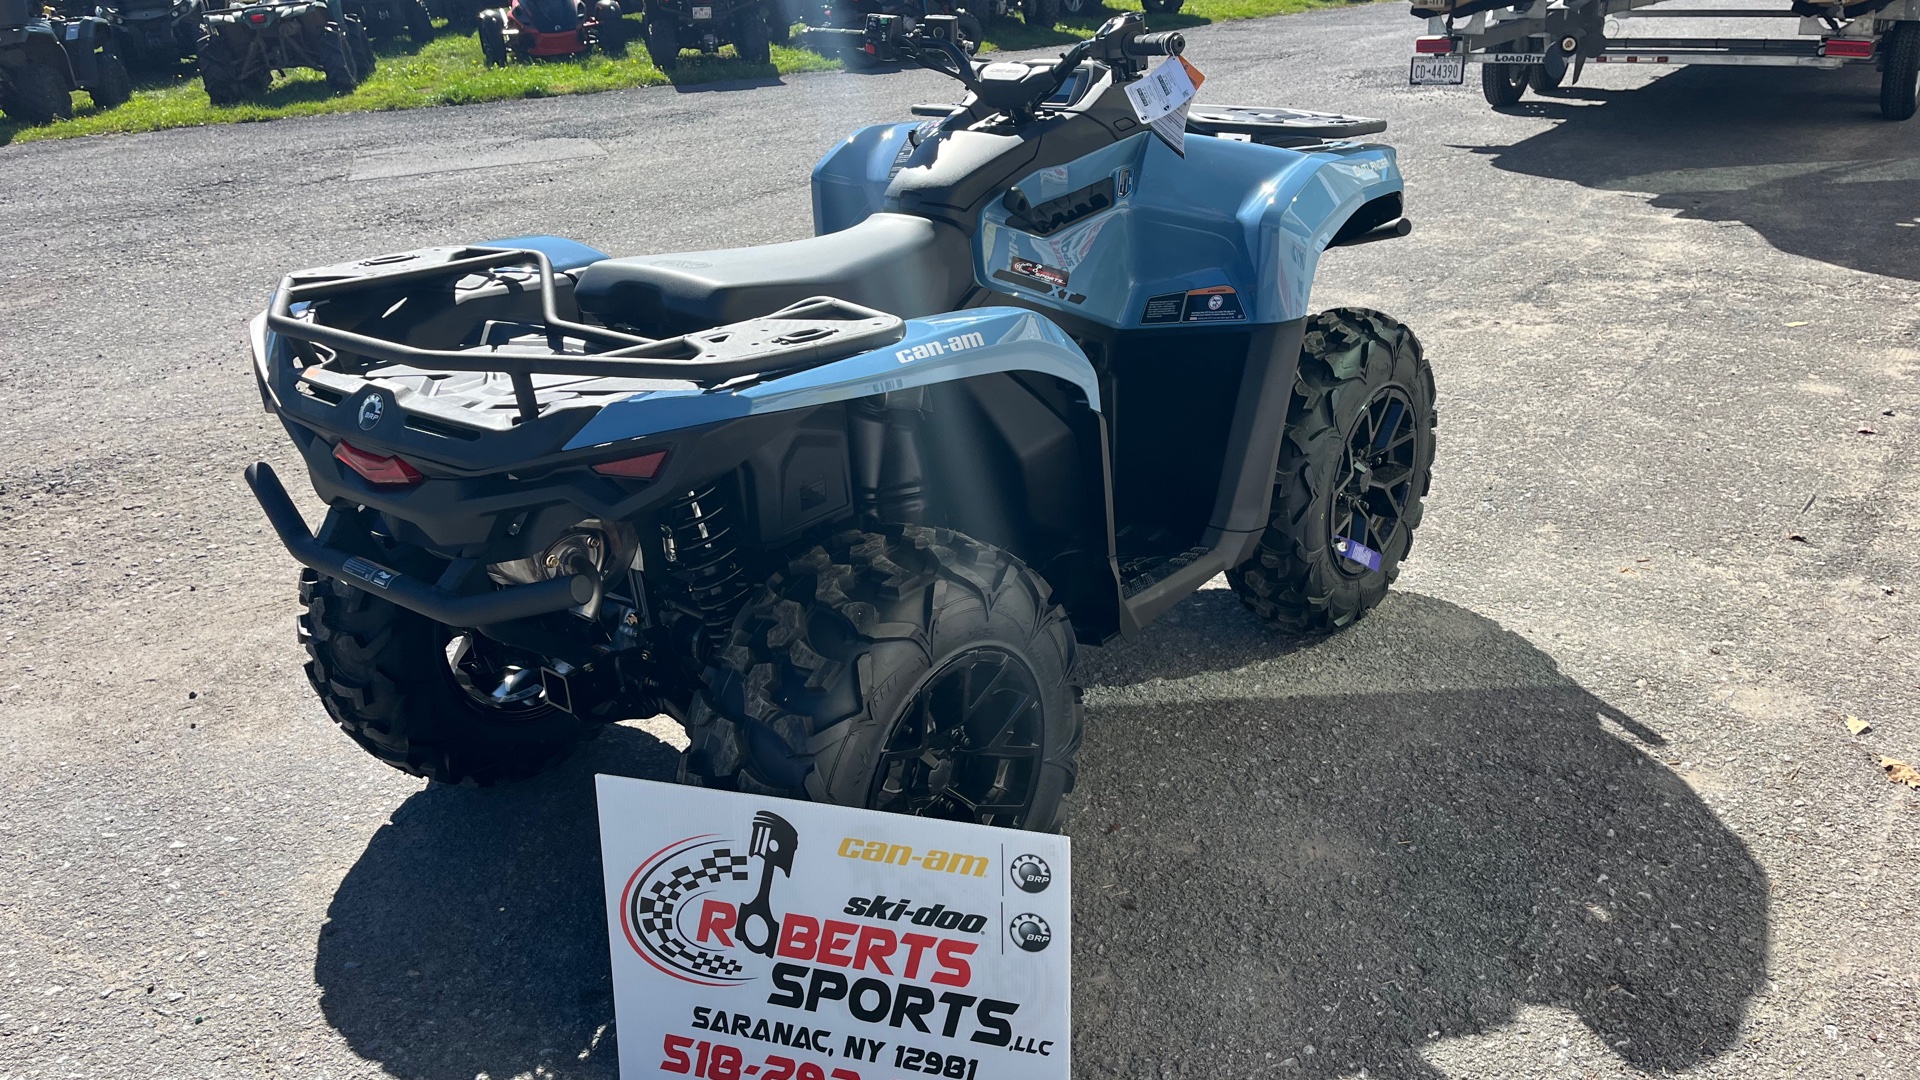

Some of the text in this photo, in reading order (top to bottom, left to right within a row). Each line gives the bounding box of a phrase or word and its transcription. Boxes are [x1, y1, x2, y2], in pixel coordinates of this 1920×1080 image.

[1494, 54, 1546, 63] LOADRIT
[1047, 284, 1077, 301] XT
[895, 331, 985, 364] can-am
[837, 837, 989, 877] can-am
[1026, 875, 1050, 884] BRP
[843, 895, 988, 934] ski-doo
[1026, 934, 1050, 943] BRP
[692, 1006, 979, 1080] SARANAC, NY 12981
